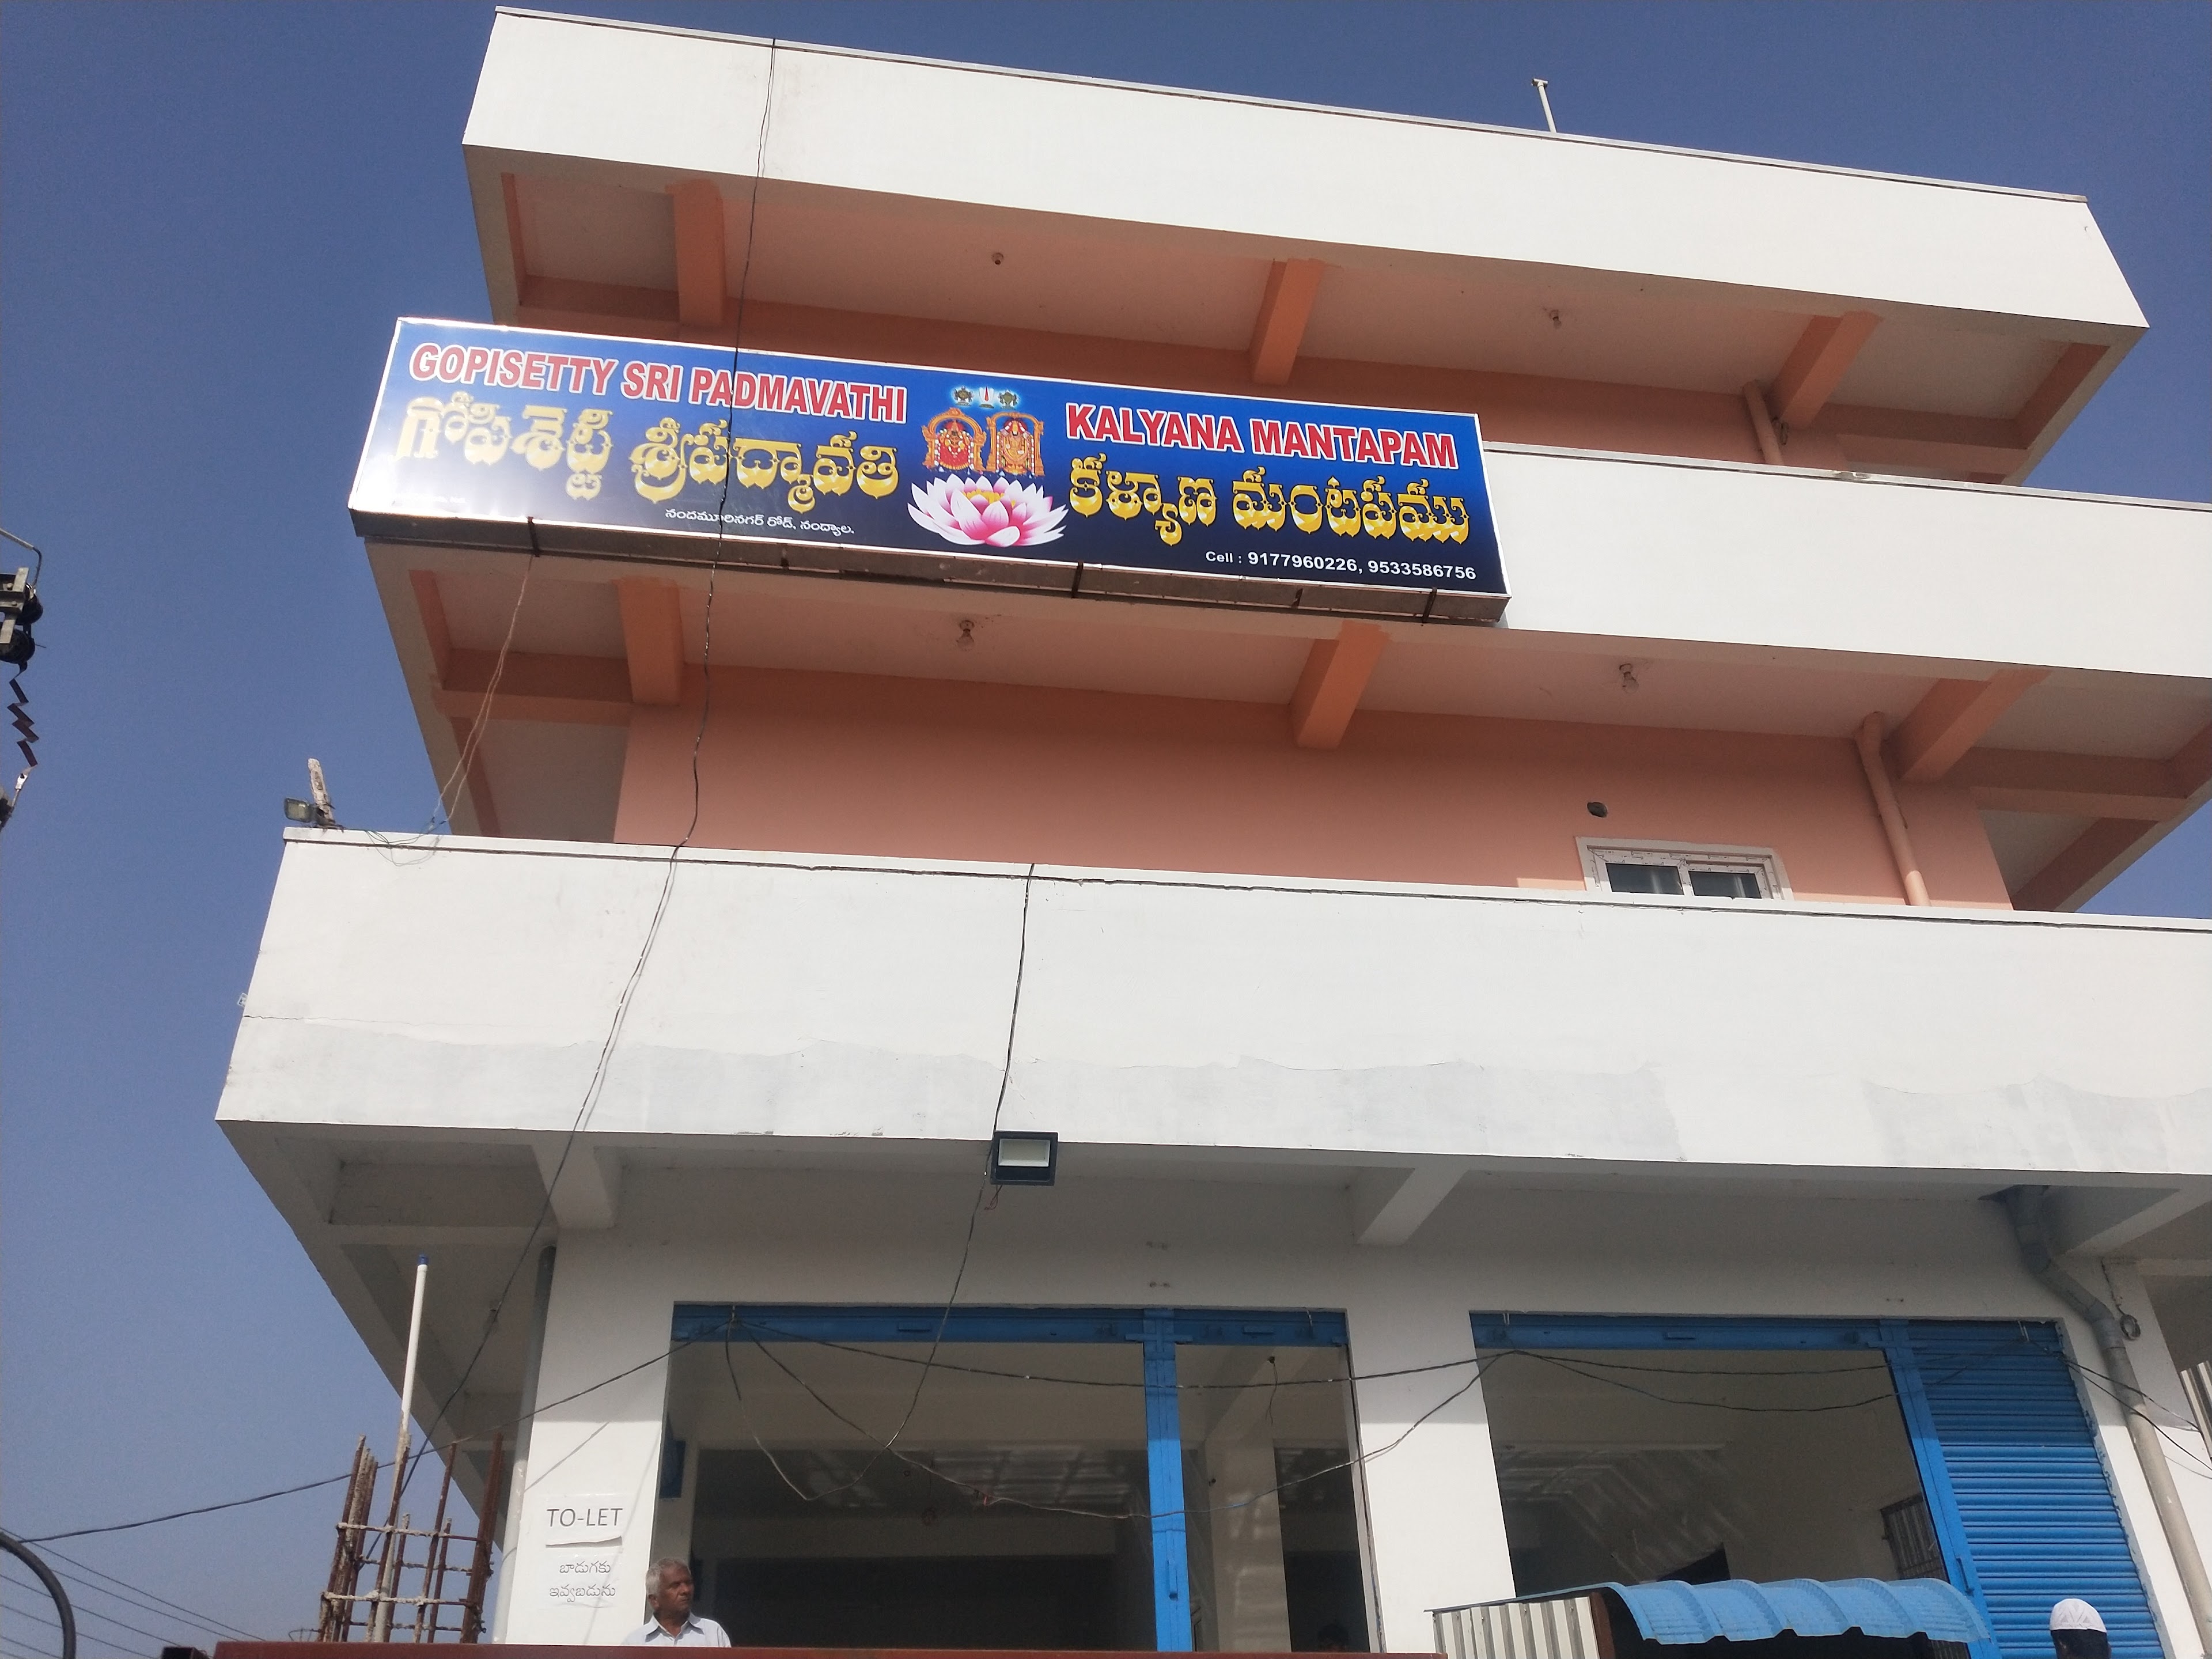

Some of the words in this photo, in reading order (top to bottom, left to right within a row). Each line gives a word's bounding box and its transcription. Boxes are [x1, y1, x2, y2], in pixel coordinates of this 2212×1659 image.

[409, 343, 619, 395] GOPISETTY
[620, 359, 684, 403] SRI
[689, 366, 908, 424] PADMAVATHI
[1066, 402, 1245, 453] KALYANA
[1250, 418, 1459, 470] MANTAPAM
[1069, 452, 1218, 547] కళ్యాణ
[1232, 466, 1470, 545] మంటపము
[1206, 551, 1233, 563] Cell
[1247, 551, 1363, 574] 9177960226,
[1368, 560, 1477, 580] 9533586756
[546, 1508, 623, 1527] TO-LET
[559, 1560, 611, 1574] బాడుగకు
